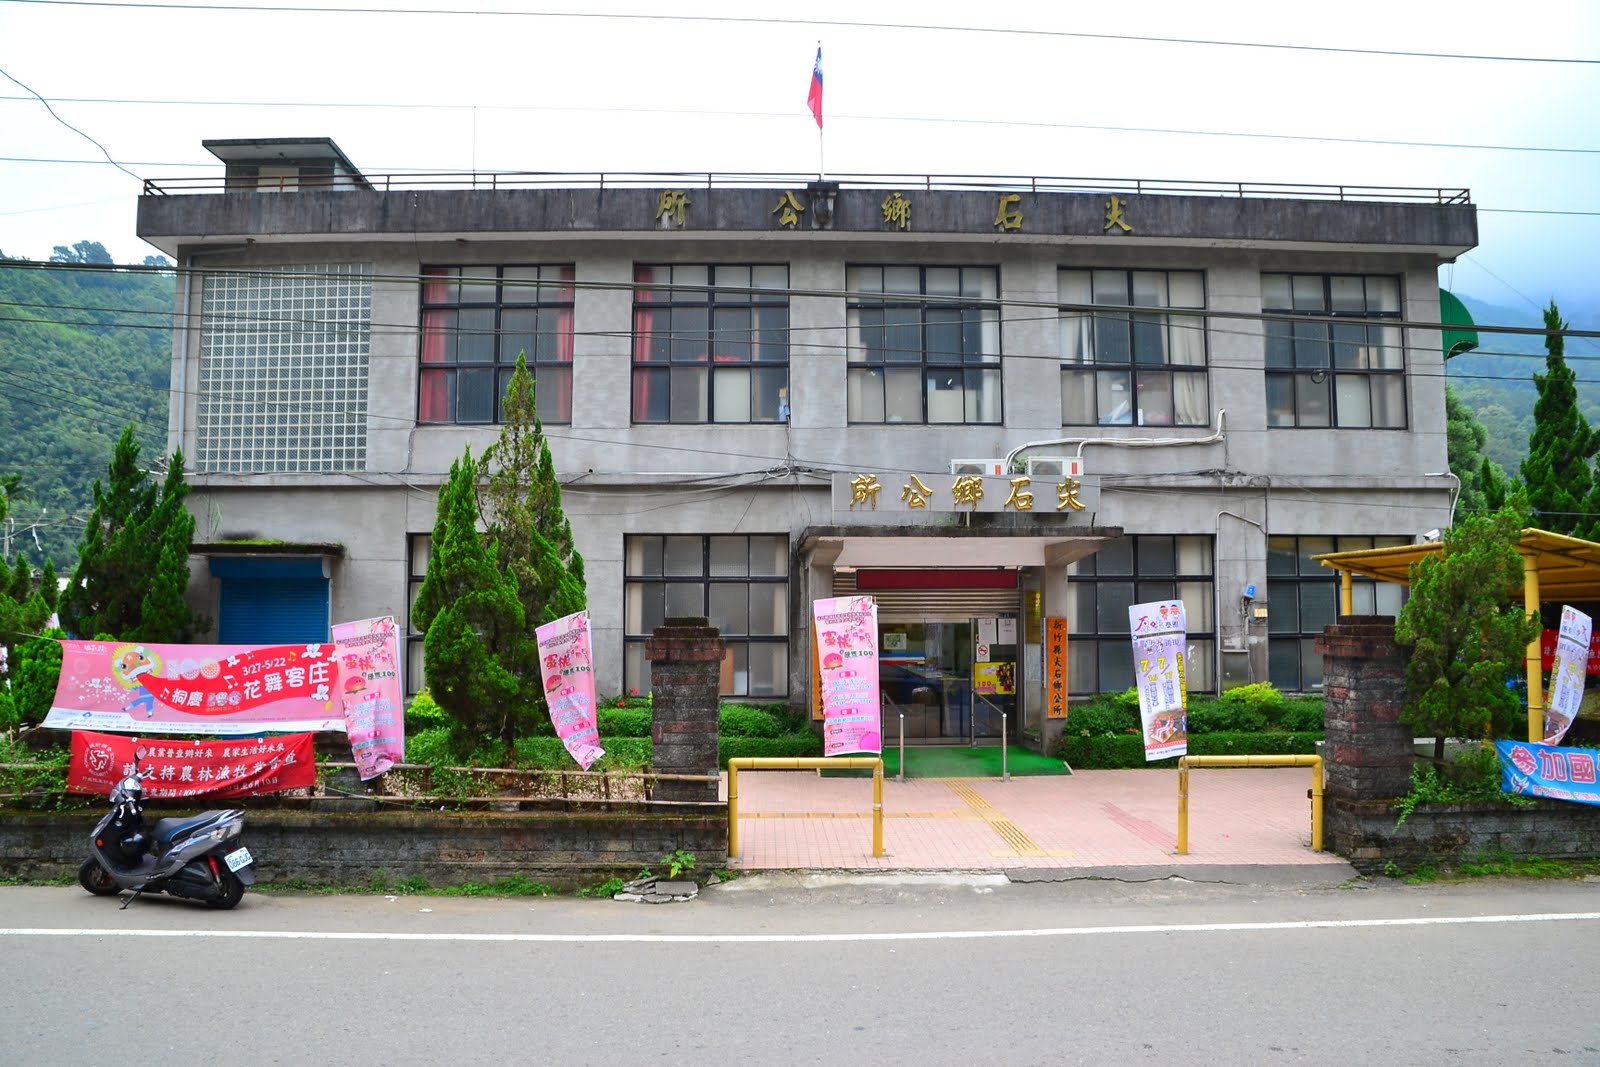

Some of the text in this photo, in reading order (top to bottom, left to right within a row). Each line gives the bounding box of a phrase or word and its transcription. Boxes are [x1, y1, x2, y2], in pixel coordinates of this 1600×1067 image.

[241, 656, 287, 677] 3/27-5/22
[1052, 620, 1064, 716] 新竹縣尖石鄉公所
[221, 741, 286, 758] 農家生活好未來
[1508, 744, 1600, 784] 參加國
